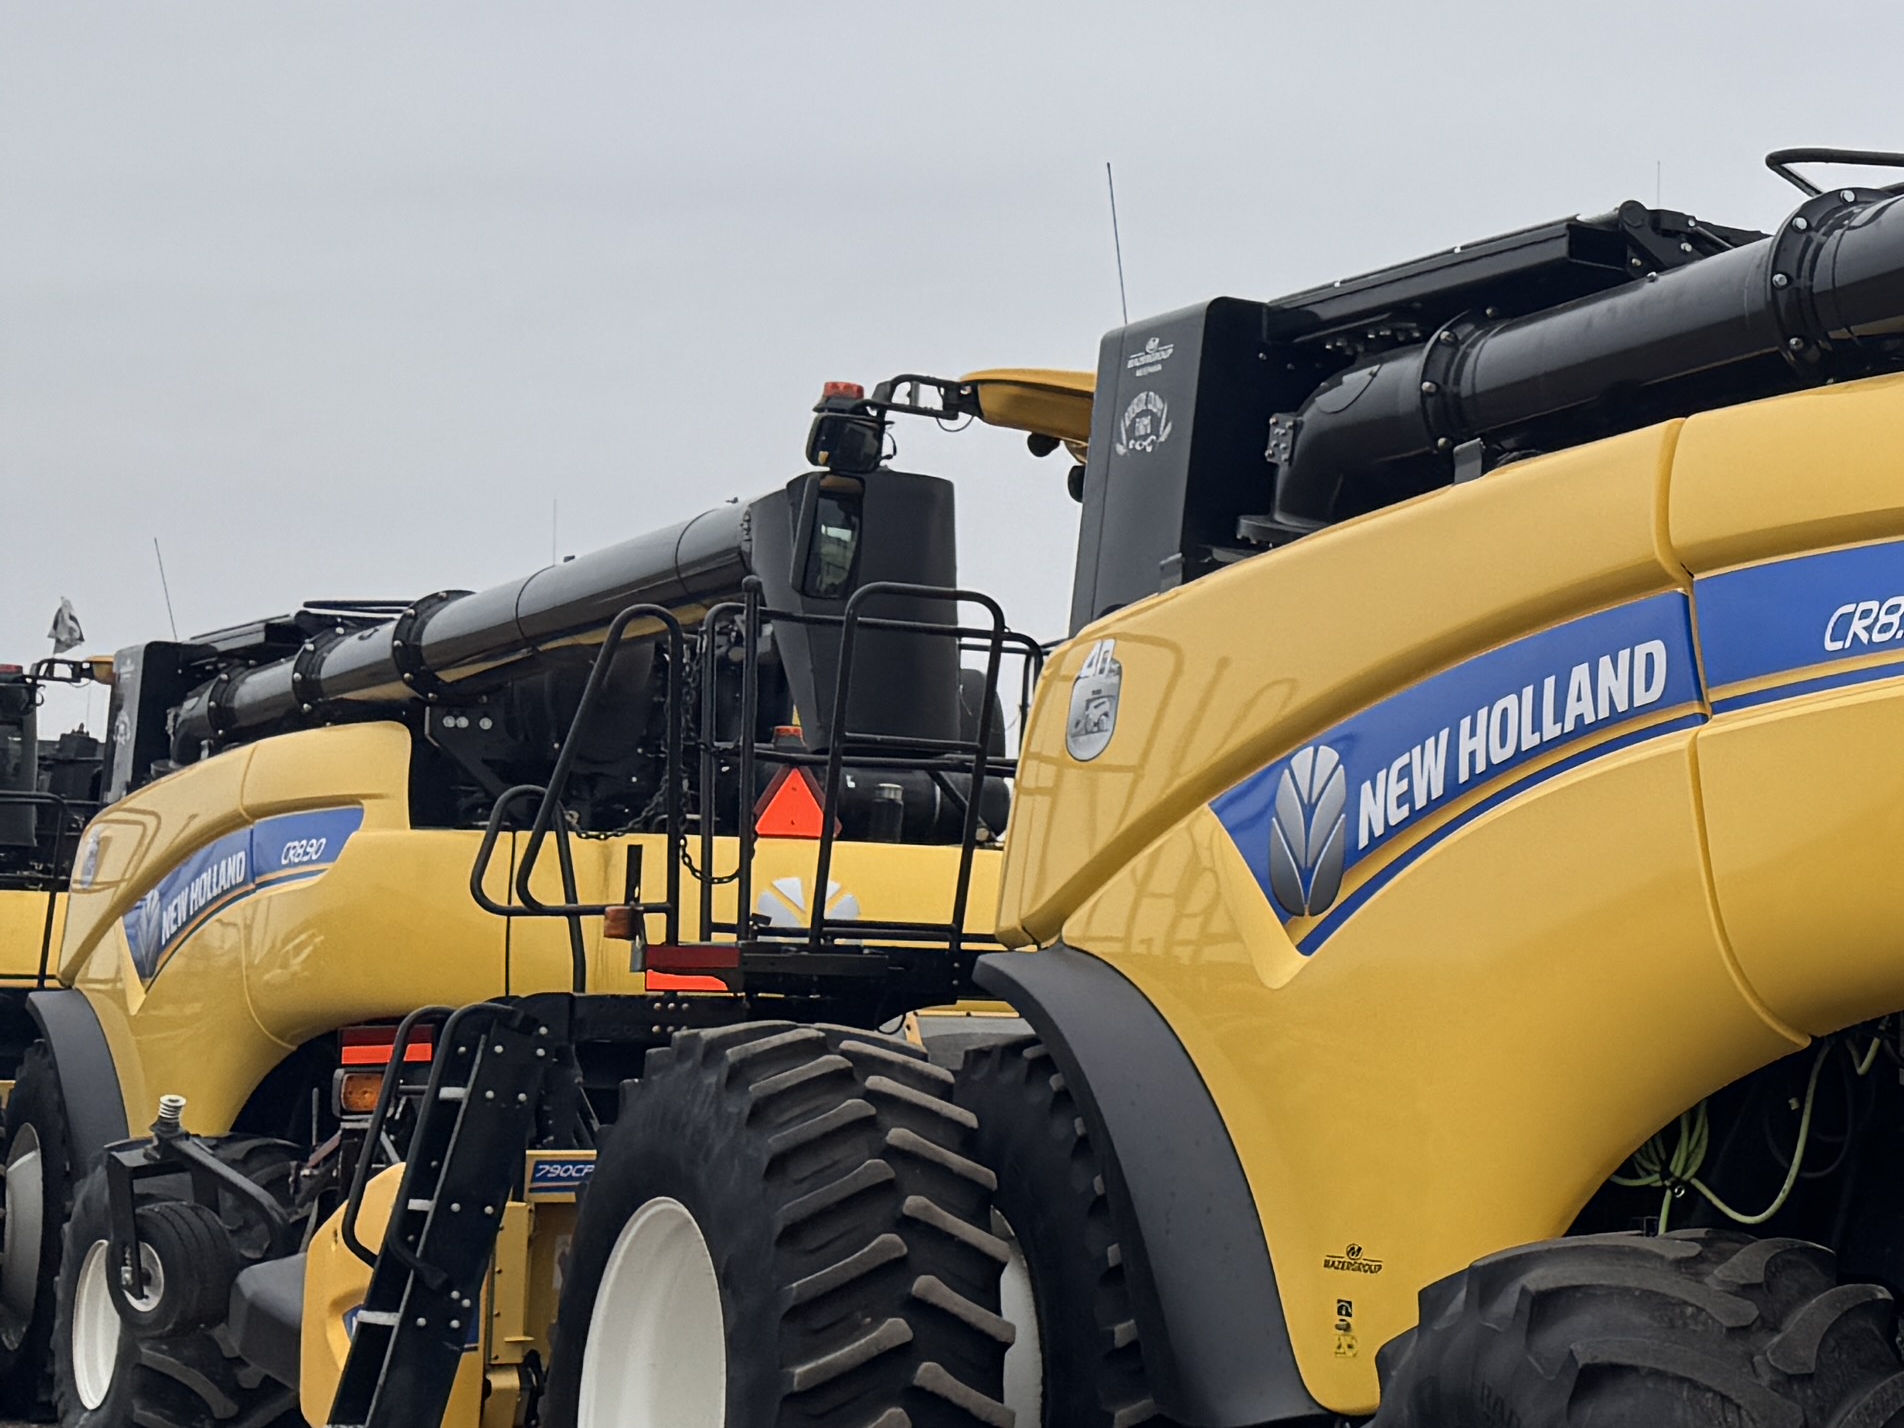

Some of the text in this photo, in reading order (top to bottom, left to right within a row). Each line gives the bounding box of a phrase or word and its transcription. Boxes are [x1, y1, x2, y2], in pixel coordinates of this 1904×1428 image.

[1358, 639, 1667, 850] NEW HOLLAND
[161, 850, 246, 946] NEW HOLLAND
